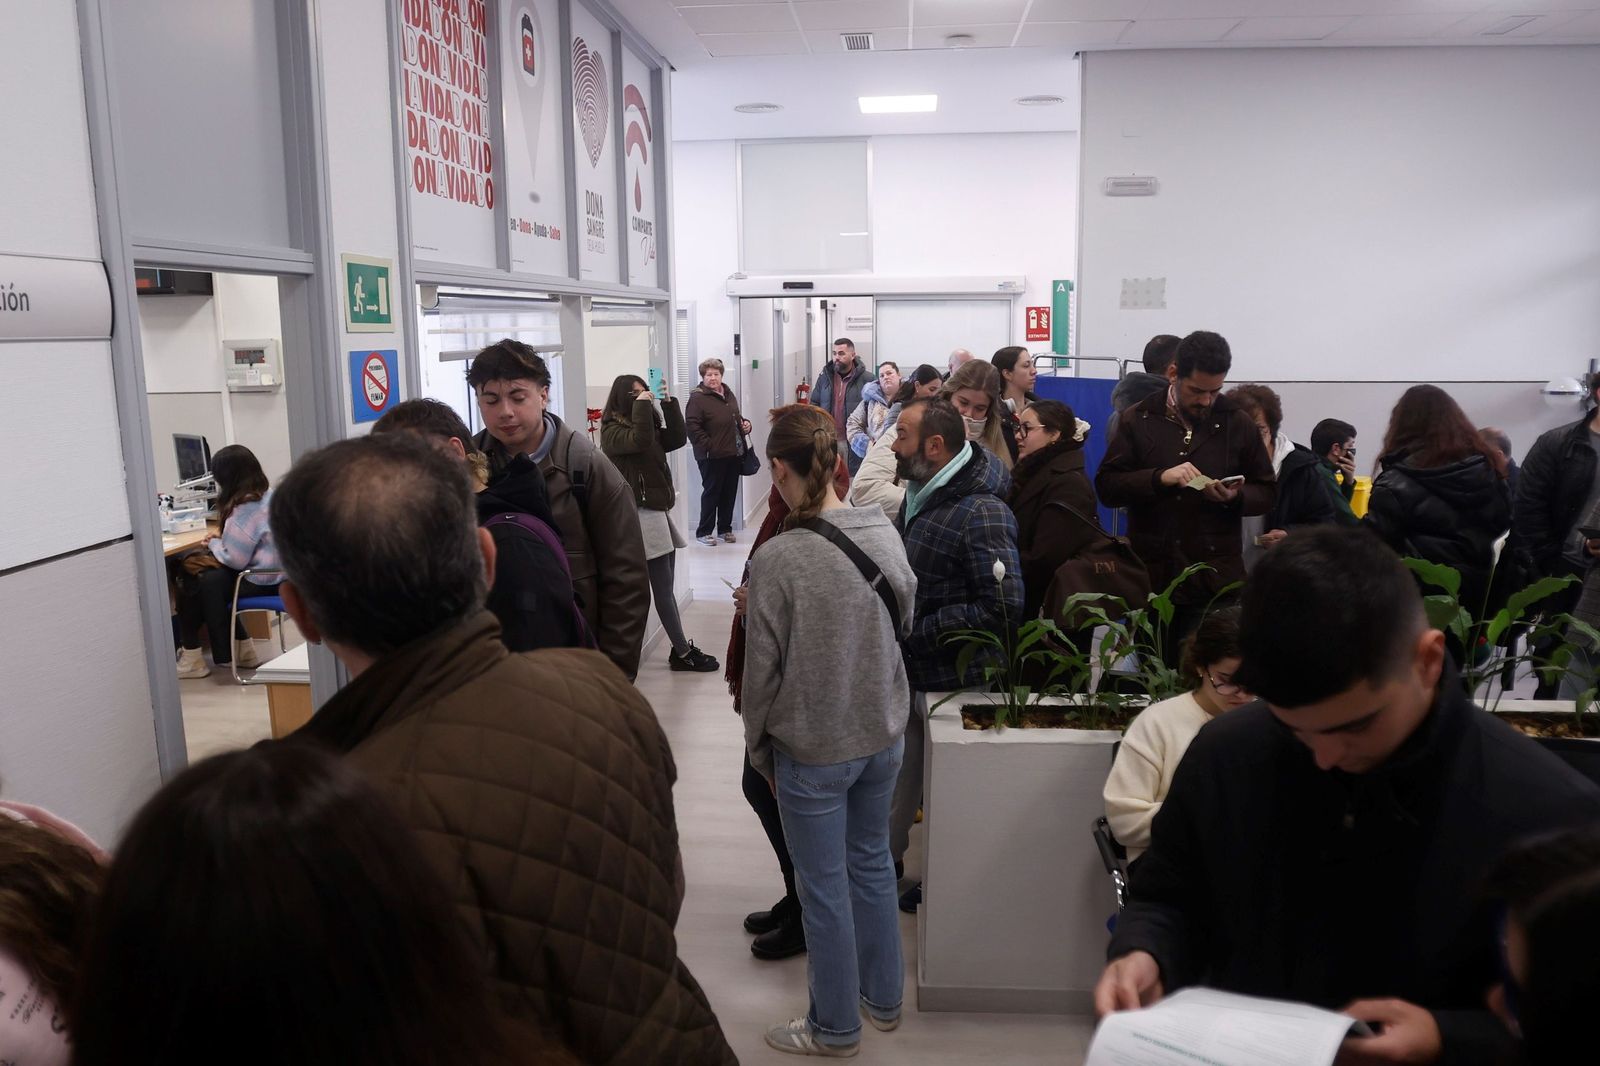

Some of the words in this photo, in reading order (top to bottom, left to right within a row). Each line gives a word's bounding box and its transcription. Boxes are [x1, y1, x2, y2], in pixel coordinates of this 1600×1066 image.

[408, 152, 494, 210] ONAVIDADO
[585, 189, 604, 220] DONA
[519, 217, 531, 234] Dona
[534, 220, 547, 237] Ayuda
[586, 217, 605, 239] SANGRE
[632, 215, 653, 237] COMPARTE
[0, 282, 30, 312] ión
[1056, 282, 1066, 292] A
[370, 391, 384, 401] FUMAR
